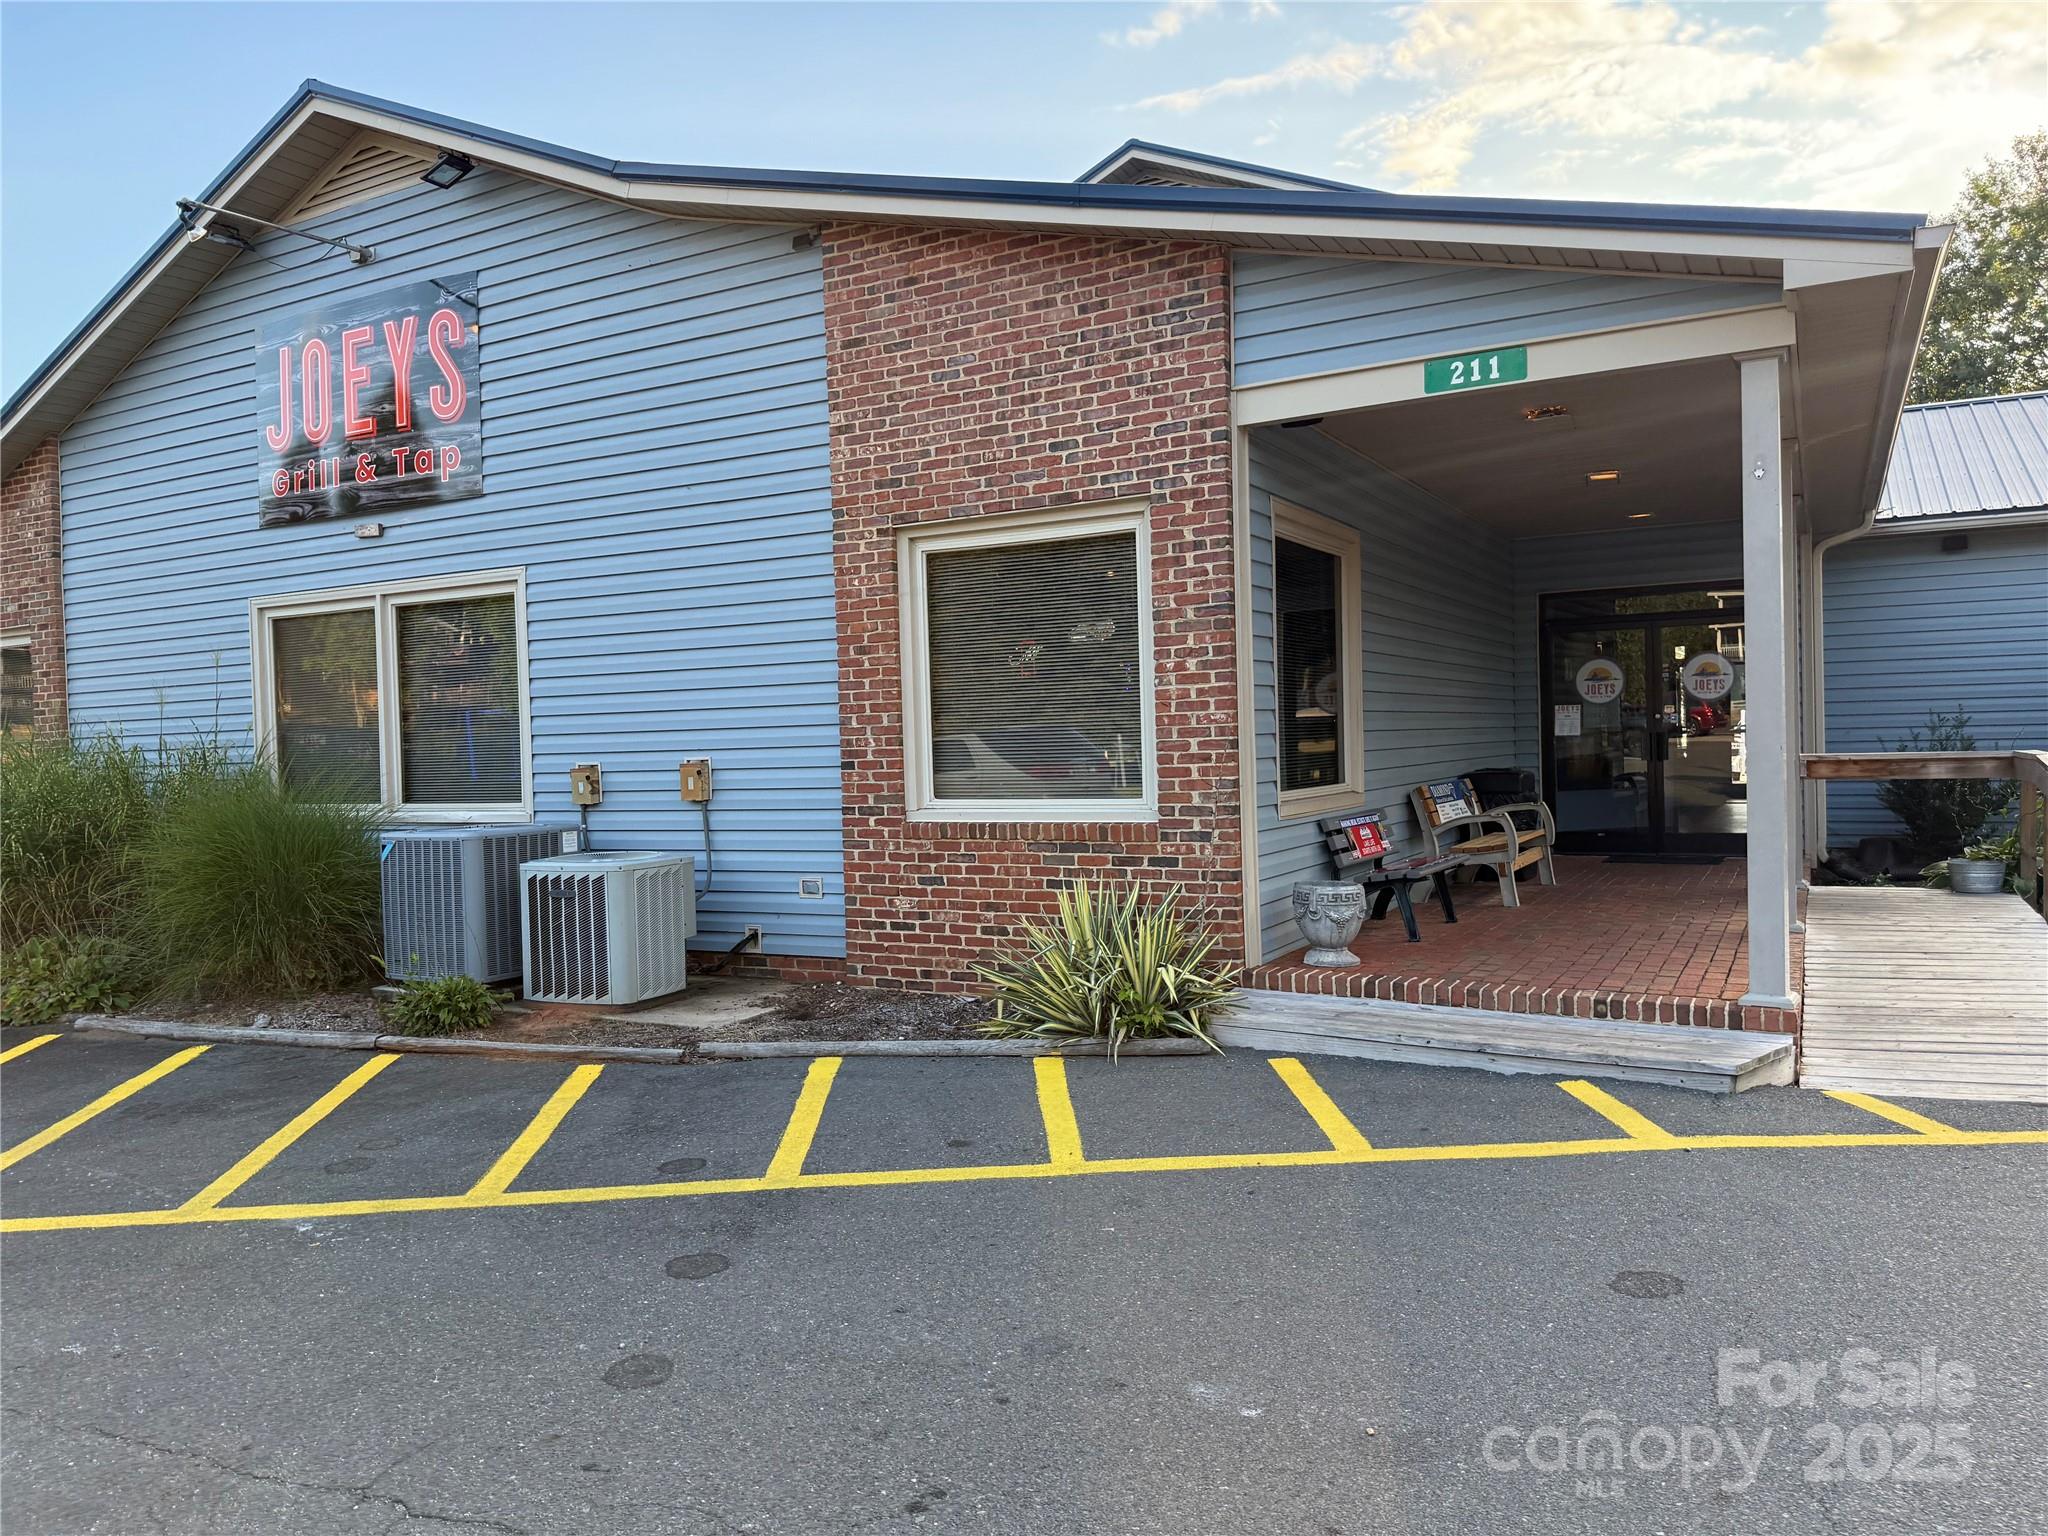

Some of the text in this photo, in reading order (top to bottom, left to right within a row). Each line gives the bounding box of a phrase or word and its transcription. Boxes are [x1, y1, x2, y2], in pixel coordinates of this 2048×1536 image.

[266, 309, 466, 452] JOEYS
[1450, 355, 1500, 385] 211
[272, 445, 462, 498] Grill & Tap
[1584, 683, 1616, 696] JOEYS
[1692, 679, 1725, 691] JOEYS
